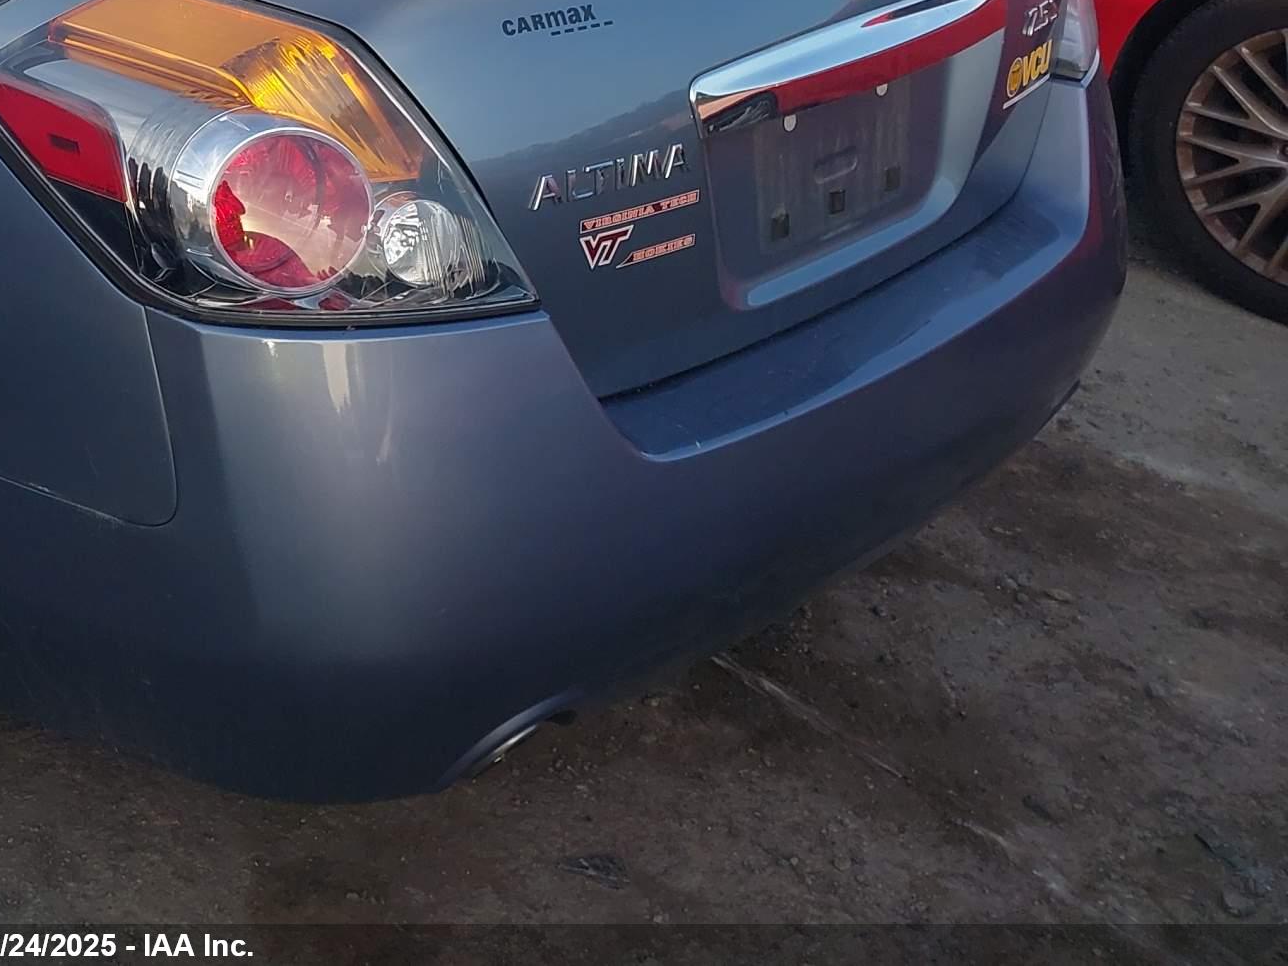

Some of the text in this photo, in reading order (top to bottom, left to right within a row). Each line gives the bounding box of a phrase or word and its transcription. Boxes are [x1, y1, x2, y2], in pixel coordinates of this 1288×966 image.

[1022, 39, 1053, 85] VCU
[528, 143, 689, 211] ALTIMA
[583, 191, 698, 230] VIRGINIA TECH
[579, 224, 635, 270] VT
